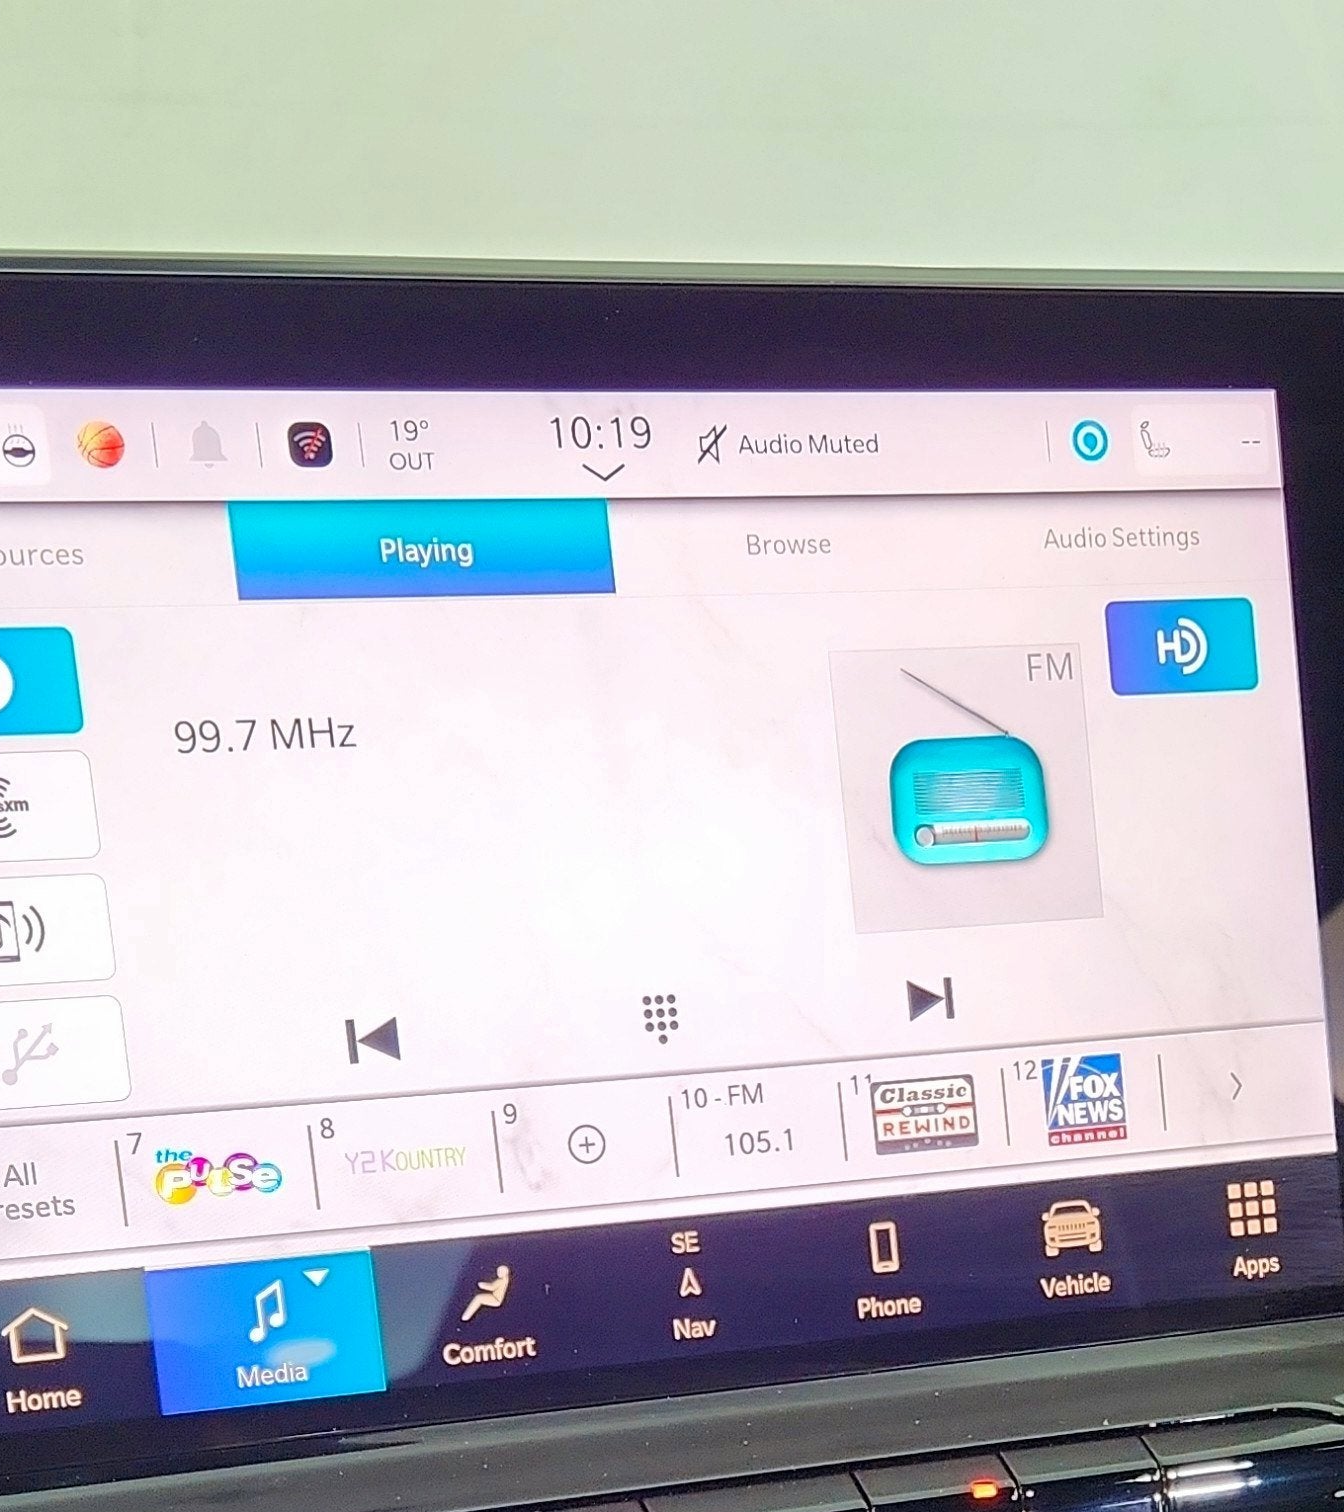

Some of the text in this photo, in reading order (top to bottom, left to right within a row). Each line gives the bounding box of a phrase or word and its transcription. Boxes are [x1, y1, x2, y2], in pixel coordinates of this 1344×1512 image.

[389, 419, 429, 442] 19°
[550, 416, 652, 451] 10:19
[739, 432, 879, 455] Audio Muted
[389, 451, 435, 471] OUT
[746, 534, 832, 557] Browse
[1044, 526, 1201, 551] Audio Settings
[379, 538, 474, 568] Playing
[1026, 652, 1074, 682] FM
[174, 717, 358, 755] 99.7 MHz
[1013, 1060, 1038, 1081] 12
[681, 1088, 708, 1110] 10
[728, 1083, 763, 1106] FM
[880, 1083, 967, 1104] Classic
[1069, 1073, 1121, 1101] FOX
[503, 1104, 518, 1125] 9
[1056, 1099, 1125, 1127] NEWS
[320, 1119, 335, 1139] 8
[883, 1116, 970, 1136] REWIND
[1050, 1127, 1125, 1145] channel
[127, 1134, 142, 1155] 7
[725, 1129, 793, 1156] 105.1
[156, 1148, 193, 1164] the
[3, 1163, 38, 1188] All
[671, 1231, 700, 1254] SE
[1233, 1254, 1281, 1281] Apps
[1040, 1272, 1112, 1299] Vehicle
[857, 1294, 922, 1319] Phone
[672, 1317, 716, 1341] Nav
[443, 1337, 537, 1365] Comfort
[237, 1362, 308, 1389] Media
[6, 1388, 83, 1414] Home
